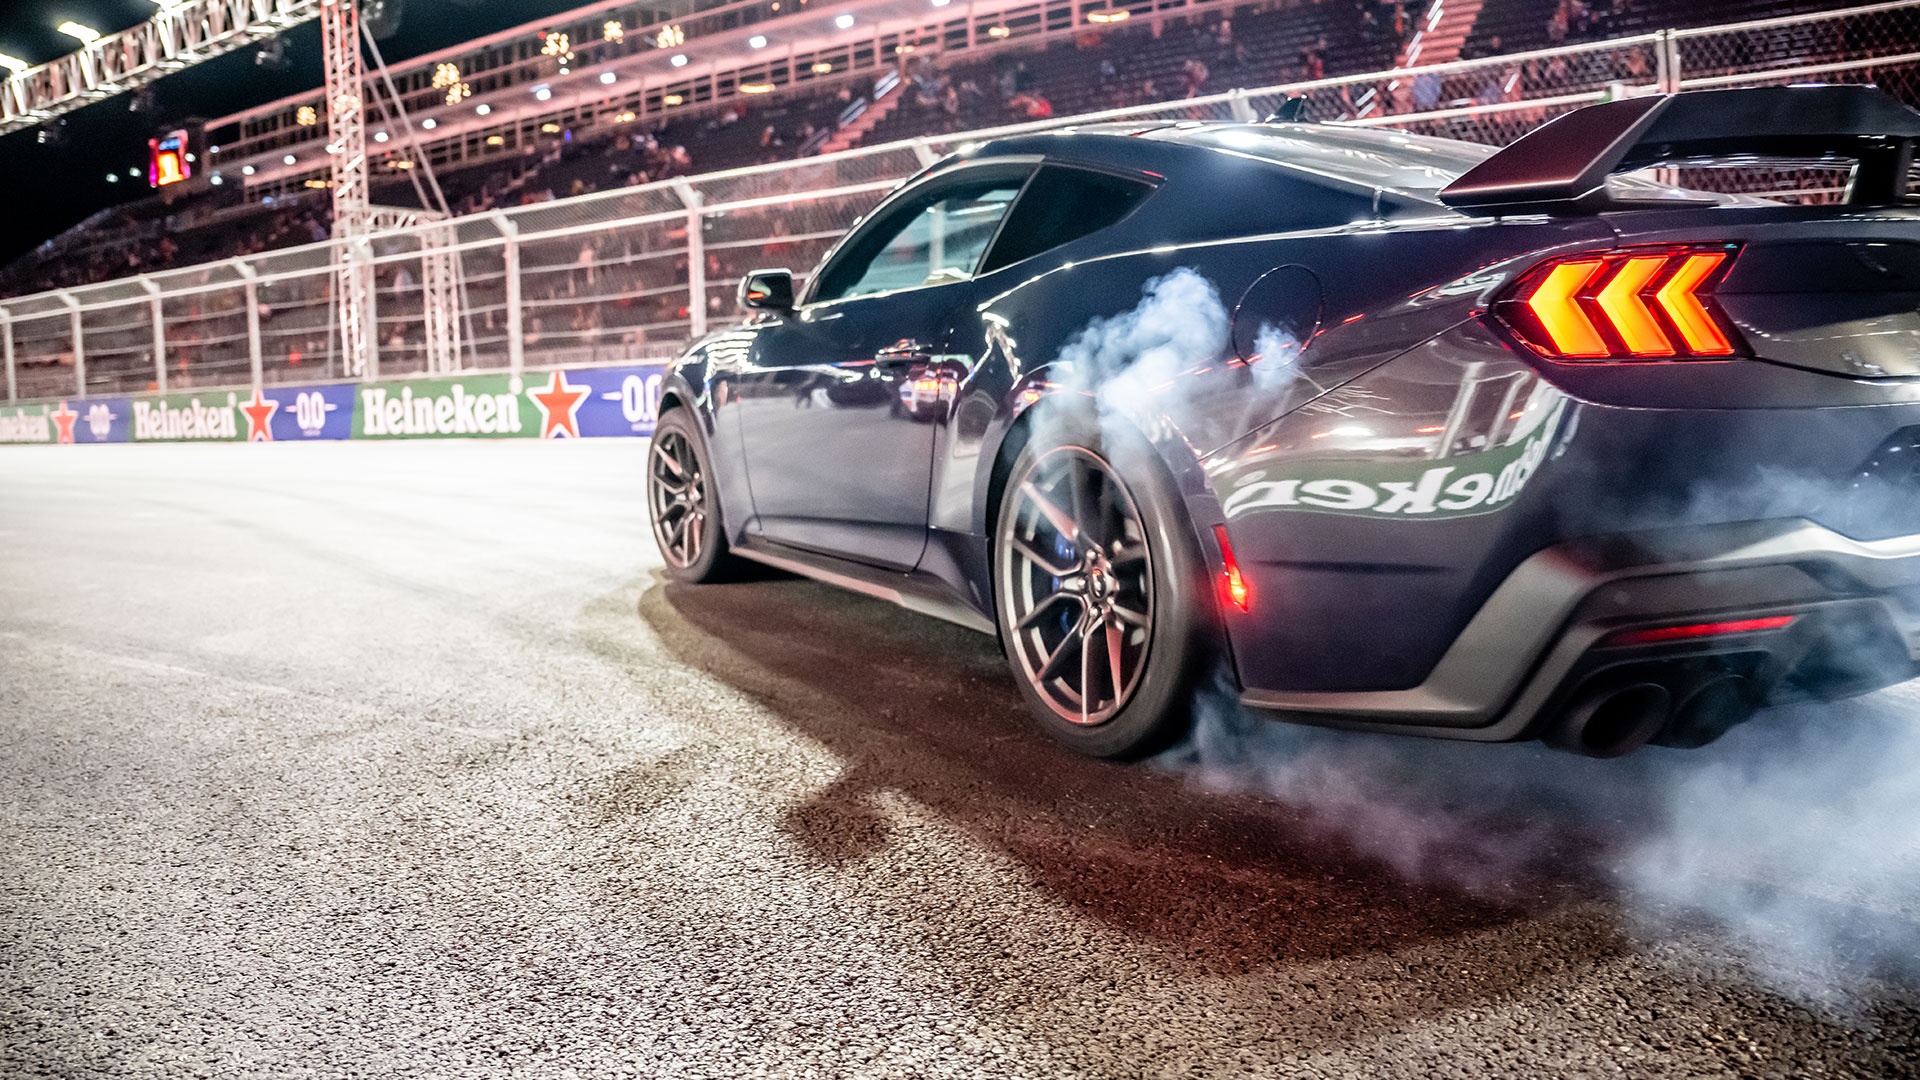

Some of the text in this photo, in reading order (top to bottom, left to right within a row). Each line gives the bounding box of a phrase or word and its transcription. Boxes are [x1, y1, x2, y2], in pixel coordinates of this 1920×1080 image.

[0, 408, 50, 441] neken
[133, 399, 237, 439] Heineken
[361, 384, 522, 435] Heineken
